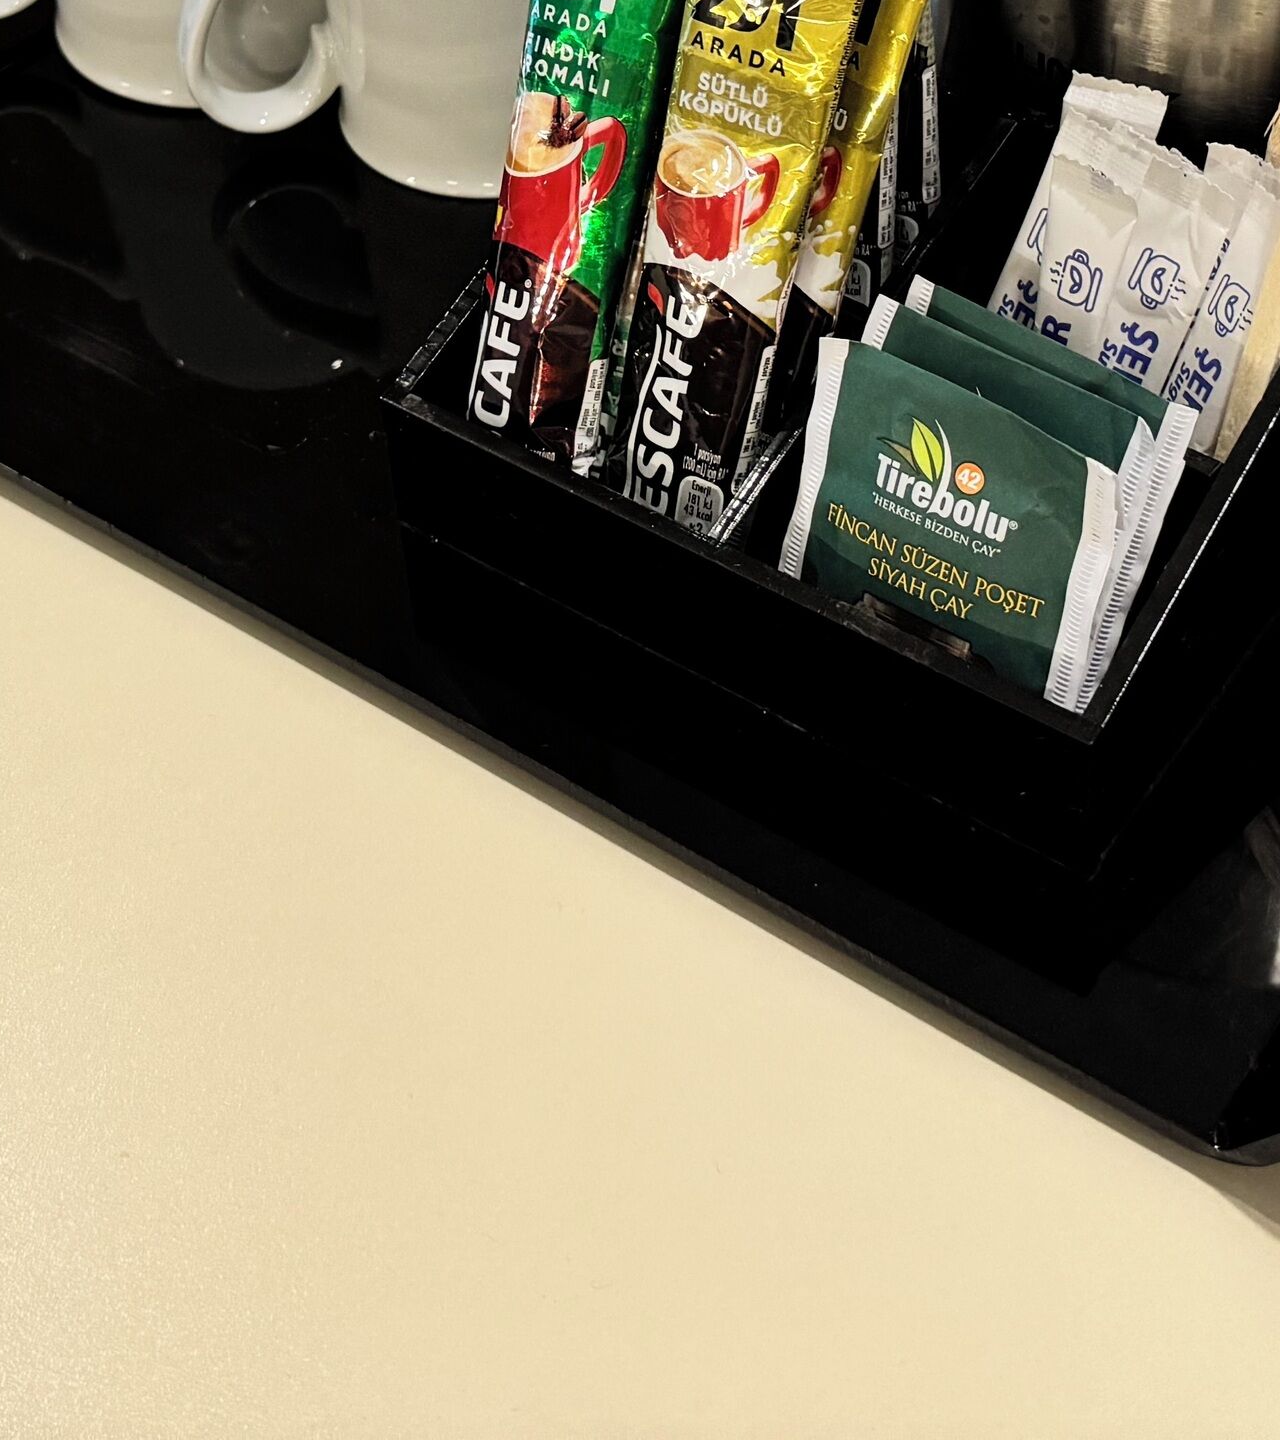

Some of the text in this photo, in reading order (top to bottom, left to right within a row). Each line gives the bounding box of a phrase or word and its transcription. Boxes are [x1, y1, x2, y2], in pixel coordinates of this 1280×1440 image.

[531, 3, 607, 38] ARADA
[691, 31, 786, 77] ARADA
[523, 57, 610, 97] ROMALI
[698, 71, 769, 109] SÜTLÜ
[678, 89, 783, 138] KÖPÜKLÜ
[633, 282, 709, 516] ESCAFÉ
[691, 479, 712, 498] Enerji
[875, 420, 1010, 543] Tirebolu
[956, 467, 981, 491] 42
[683, 502, 713, 523] 43 kcal
[687, 491, 701, 508] 181
[924, 515, 970, 547] BİZDEN
[826, 502, 1046, 620] FİNCAN SÜZEN POŞET
[867, 557, 974, 621] SİYAH ÇAY
